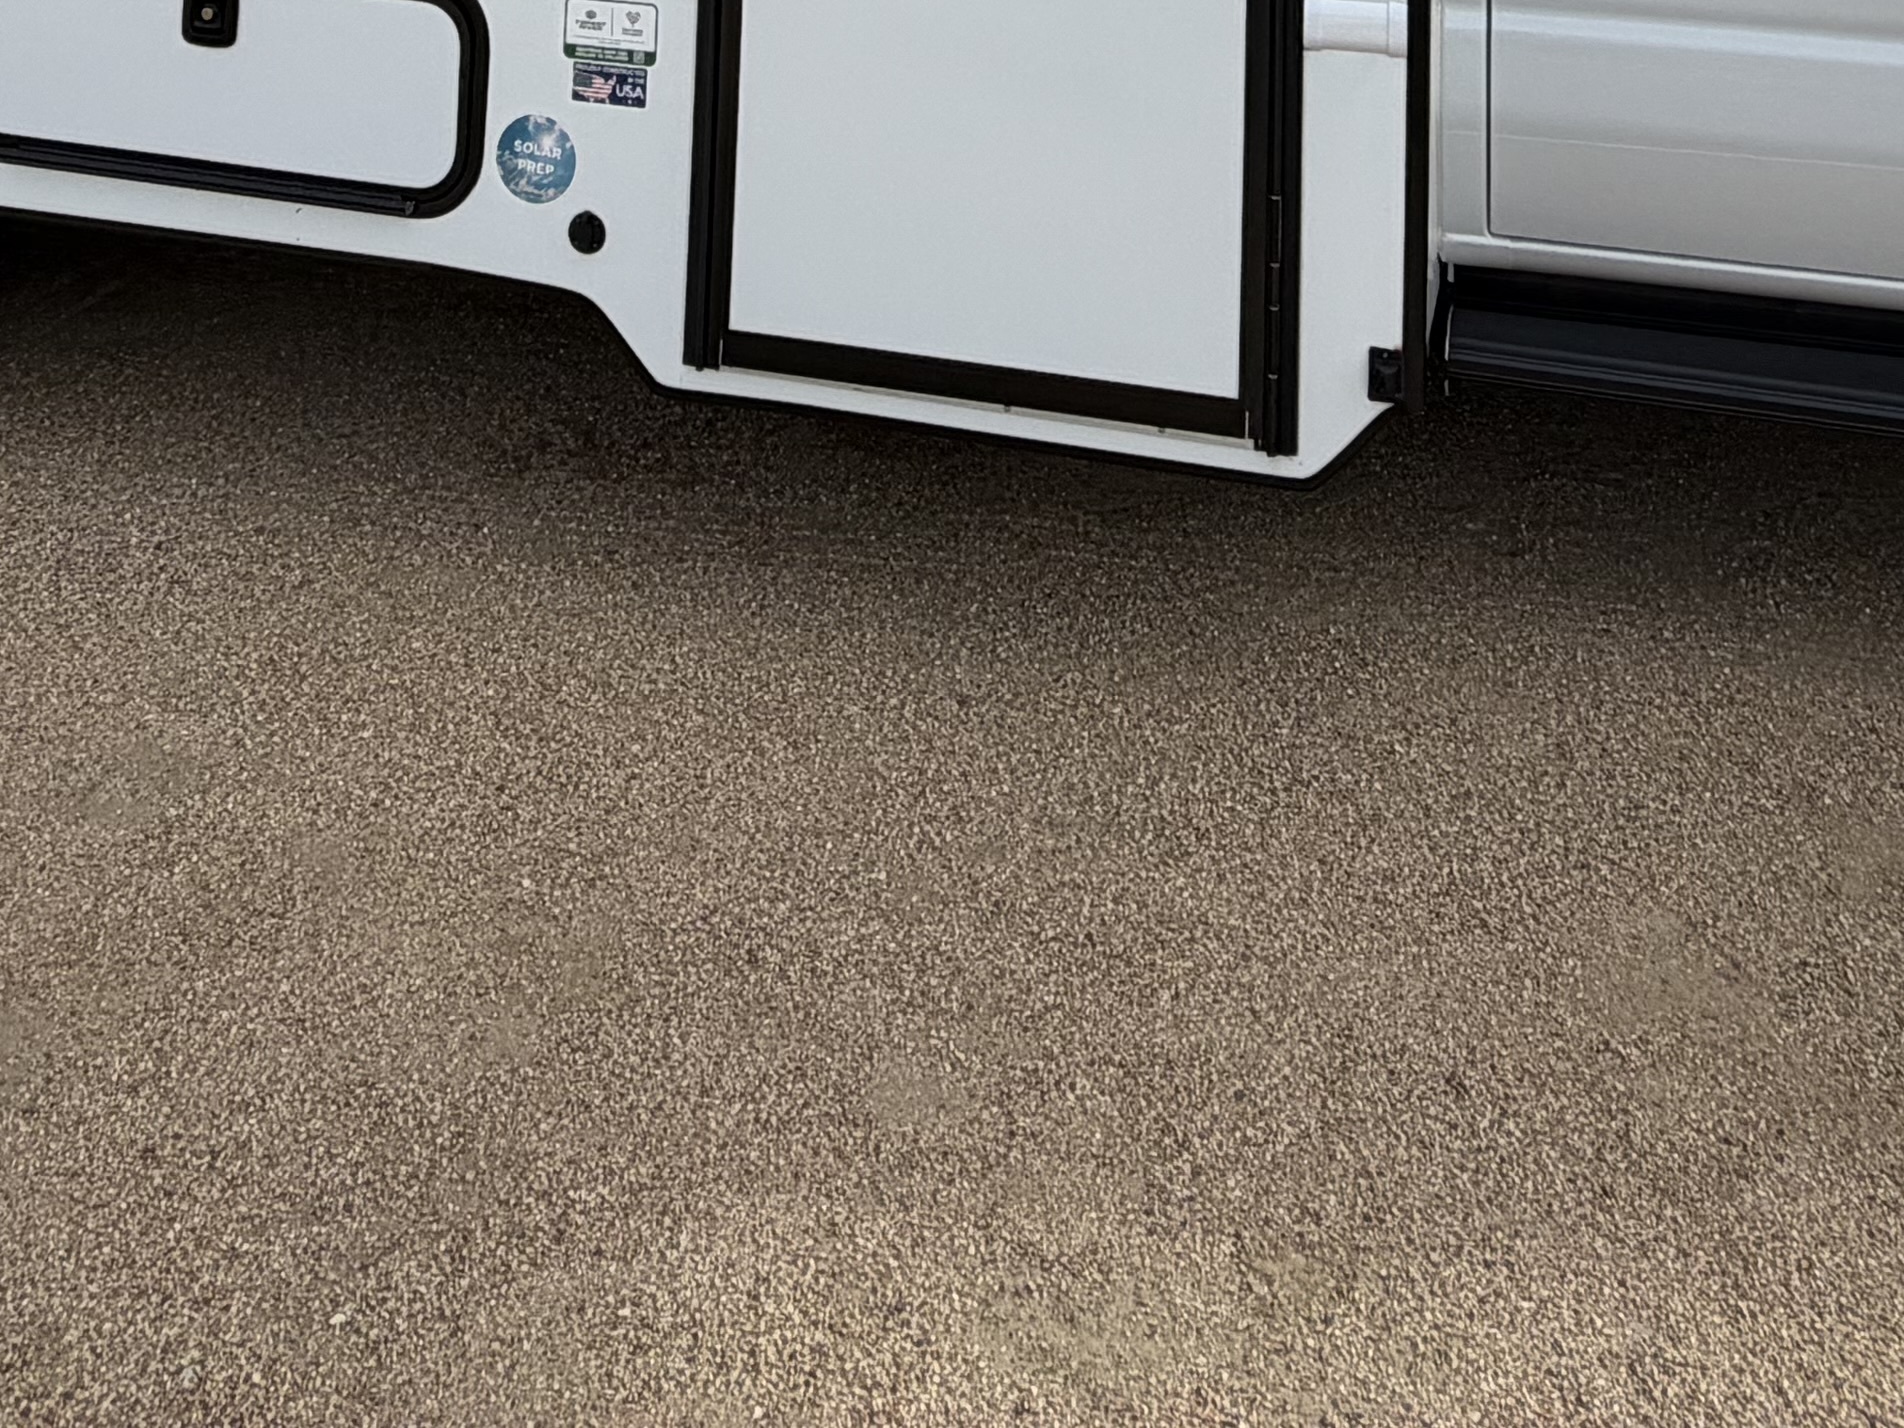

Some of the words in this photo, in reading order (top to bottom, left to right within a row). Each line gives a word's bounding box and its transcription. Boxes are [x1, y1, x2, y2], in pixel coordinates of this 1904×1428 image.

[616, 83, 645, 100] USA
[513, 138, 563, 161] SOLAR
[517, 158, 555, 175] PREP
